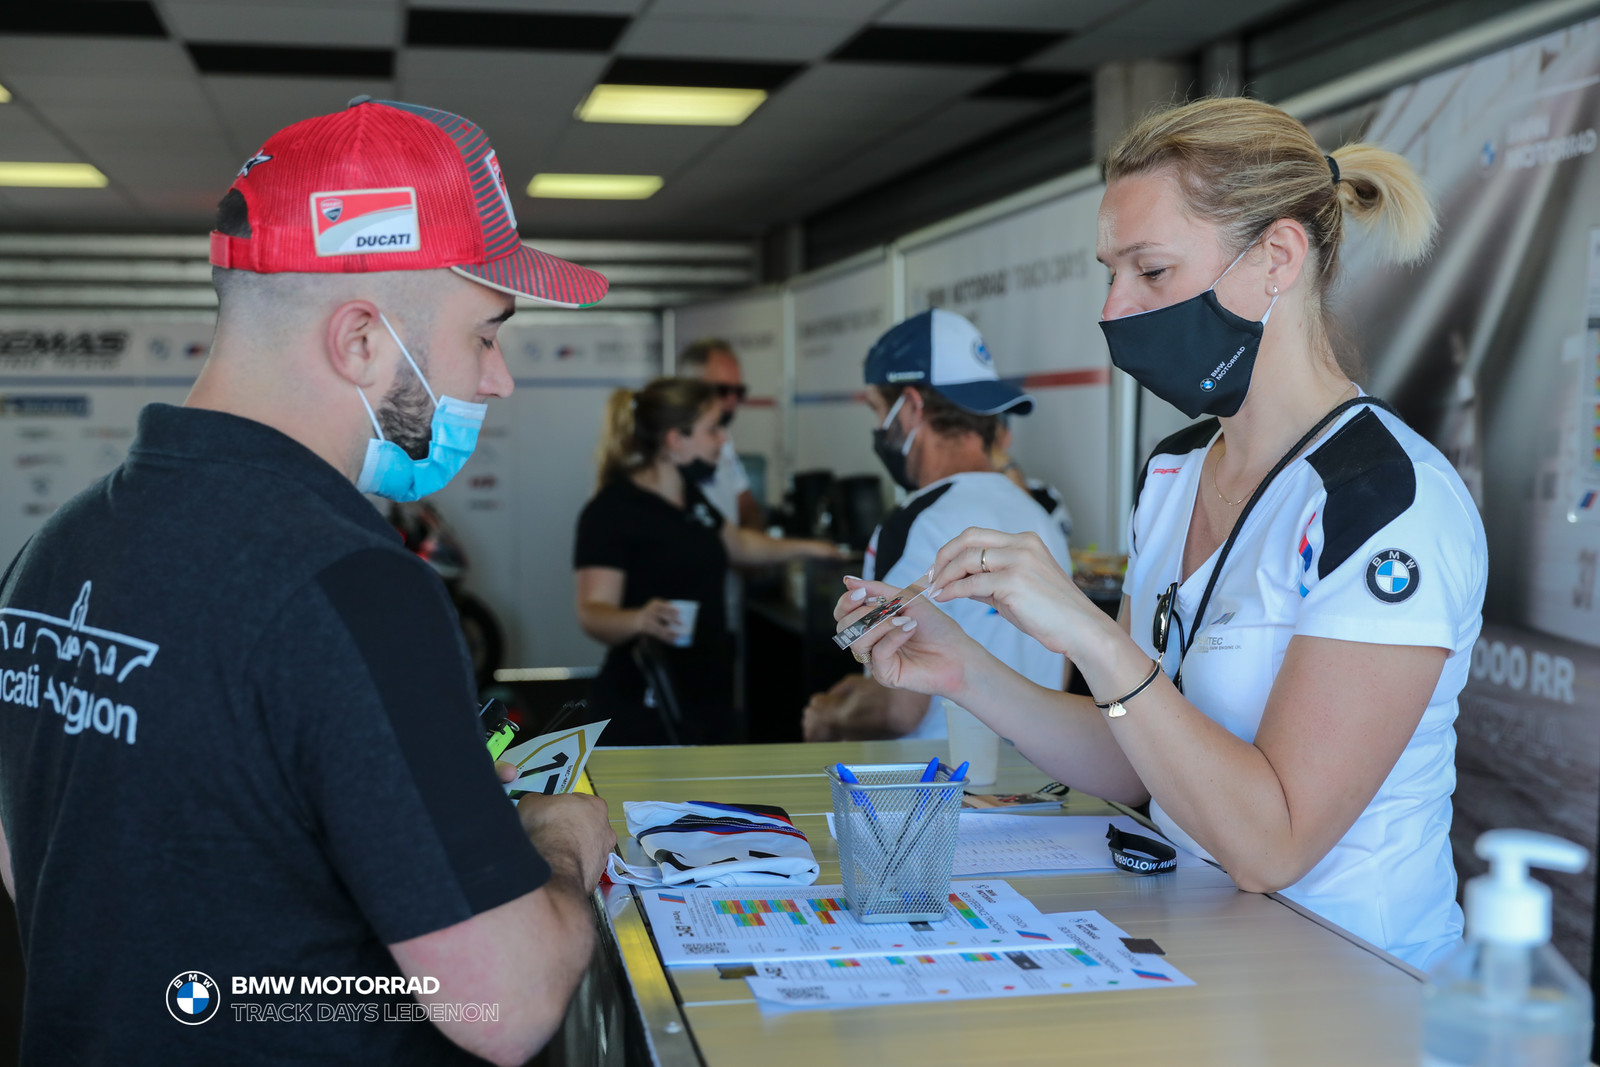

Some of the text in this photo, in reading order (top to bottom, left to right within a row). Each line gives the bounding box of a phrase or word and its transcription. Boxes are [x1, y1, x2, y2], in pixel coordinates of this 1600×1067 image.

[356, 234, 410, 247] DUCATI
[1211, 361, 1226, 377] BMW
[1216, 346, 1245, 380] MOTORRAD
[1531, 651, 1575, 704] RR
